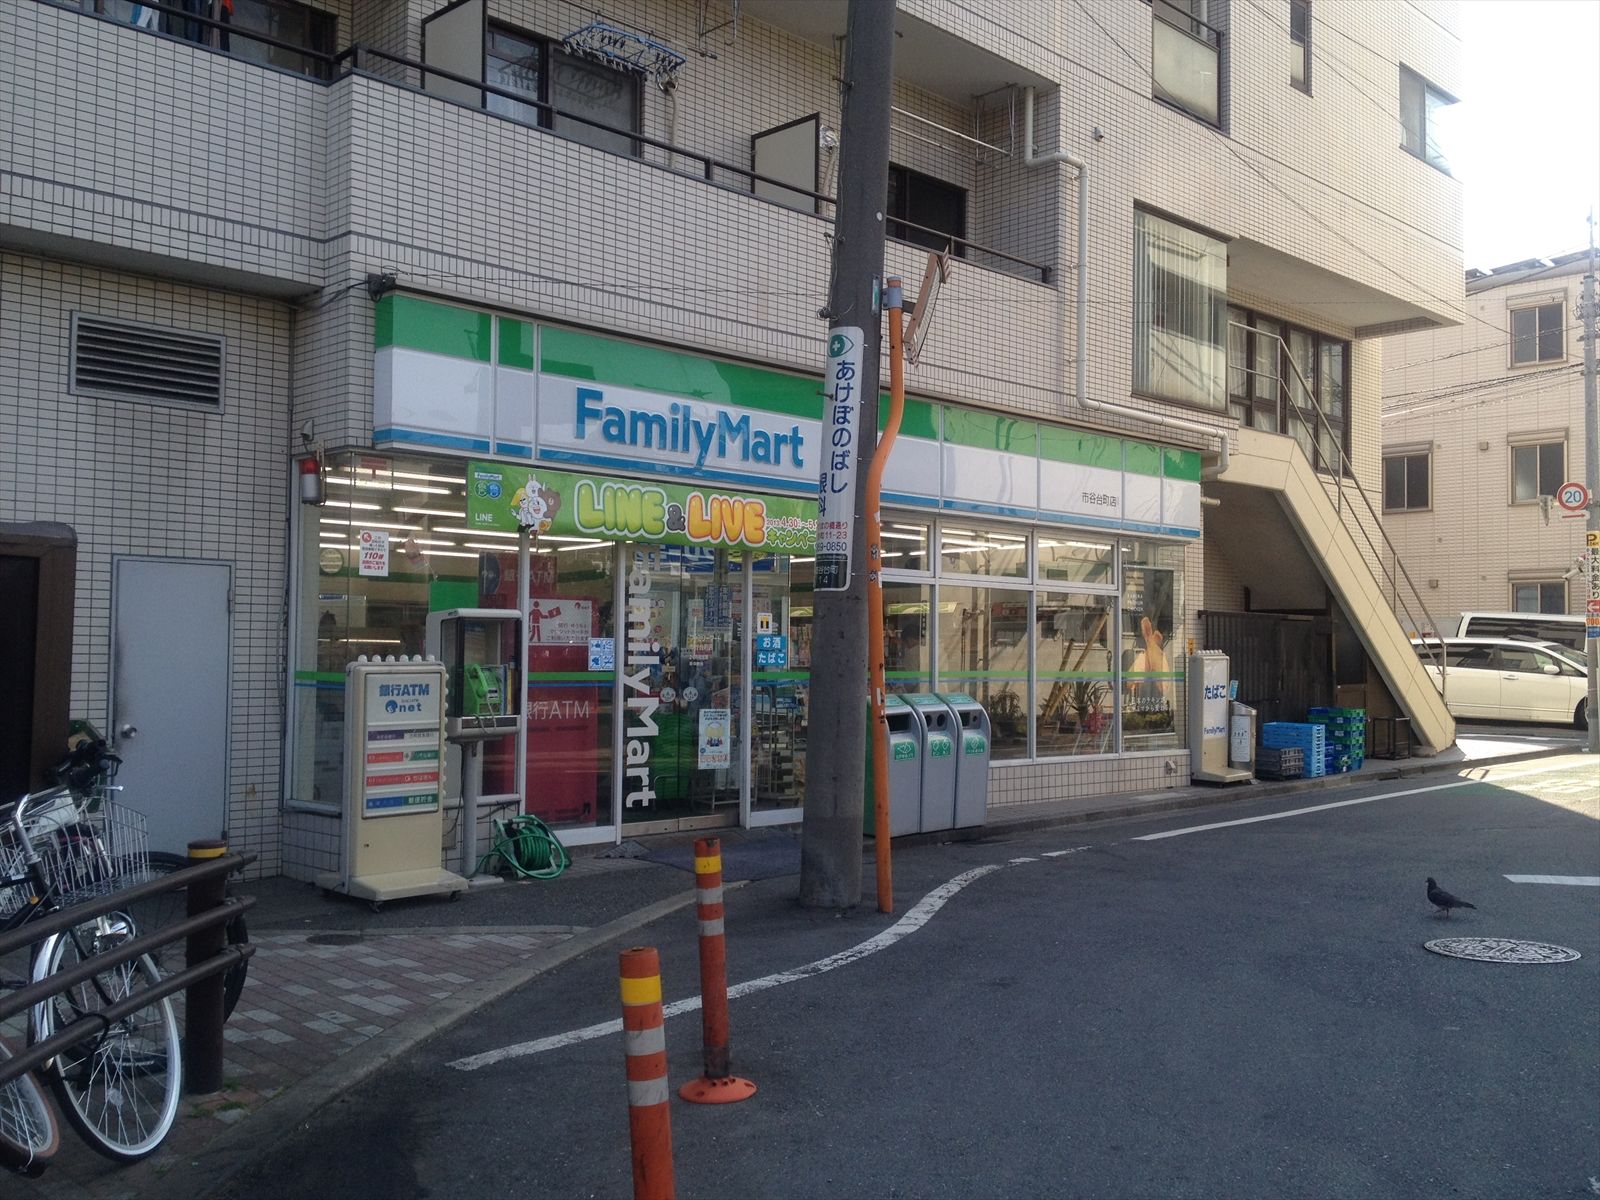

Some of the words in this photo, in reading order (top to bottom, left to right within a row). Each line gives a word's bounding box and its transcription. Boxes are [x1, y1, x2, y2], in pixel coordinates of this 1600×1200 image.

[574, 386, 804, 469] FamilyMart
[830, 360, 855, 494] あけぼのばし
[1082, 492, 1117, 507] 市谷台町店
[1564, 490, 1582, 503] 20
[475, 513, 493, 522] LINE
[576, 481, 667, 537] LINE
[667, 503, 686, 532] &
[687, 493, 765, 544] LIVE
[1591, 547, 1600, 600] 最大料金あり
[762, 637, 781, 648] お酒
[758, 652, 785, 664] たばこ
[379, 684, 430, 697] 銀行ATM
[1204, 685, 1226, 700] たばこ
[1204, 727, 1226, 736] FamilyMart
